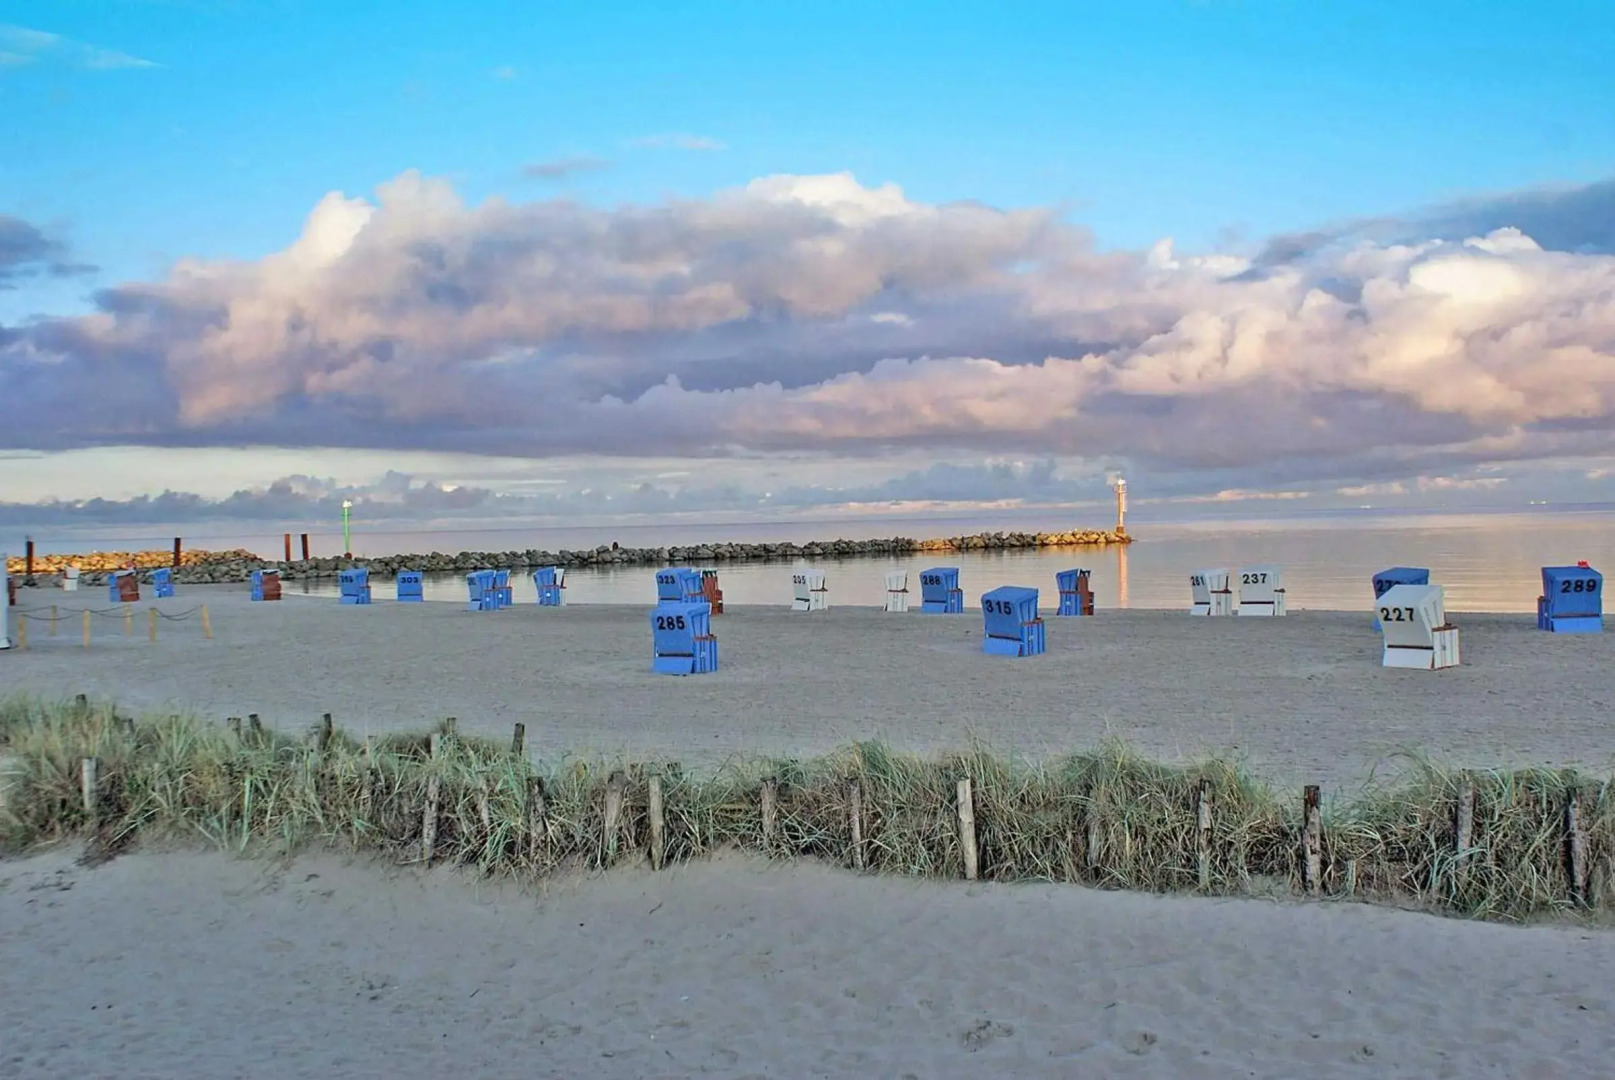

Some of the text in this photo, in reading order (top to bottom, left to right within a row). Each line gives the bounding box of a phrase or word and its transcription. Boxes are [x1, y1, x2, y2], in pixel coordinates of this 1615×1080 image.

[658, 575, 676, 584] 323
[922, 575, 940, 586] 288
[1242, 574, 1267, 584] 237
[1375, 579, 1401, 593] 27
[1561, 579, 1597, 593] 289
[986, 600, 1012, 615] 315
[1381, 607, 1415, 622] 227
[656, 615, 685, 631] 285
